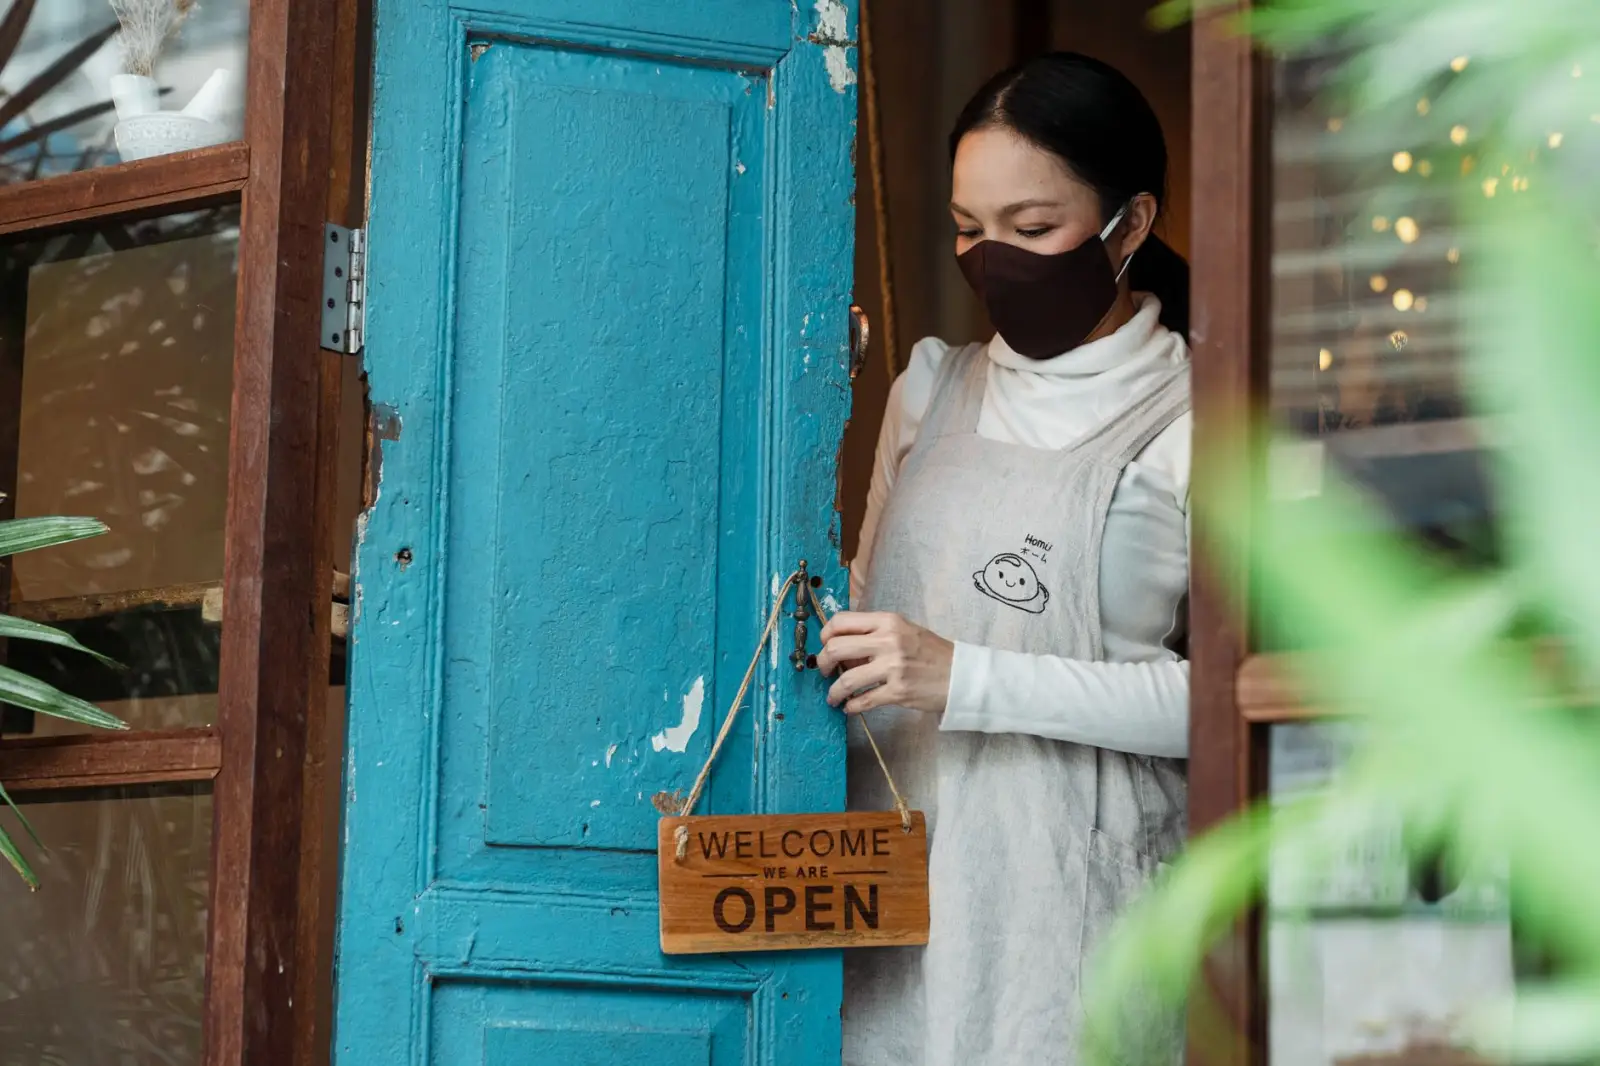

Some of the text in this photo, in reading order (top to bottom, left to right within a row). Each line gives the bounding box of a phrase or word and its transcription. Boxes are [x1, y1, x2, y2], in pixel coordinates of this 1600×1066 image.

[699, 828, 891, 859] WELCOME
[763, 865, 829, 879] WE ARE
[712, 884, 880, 934] OPEN
